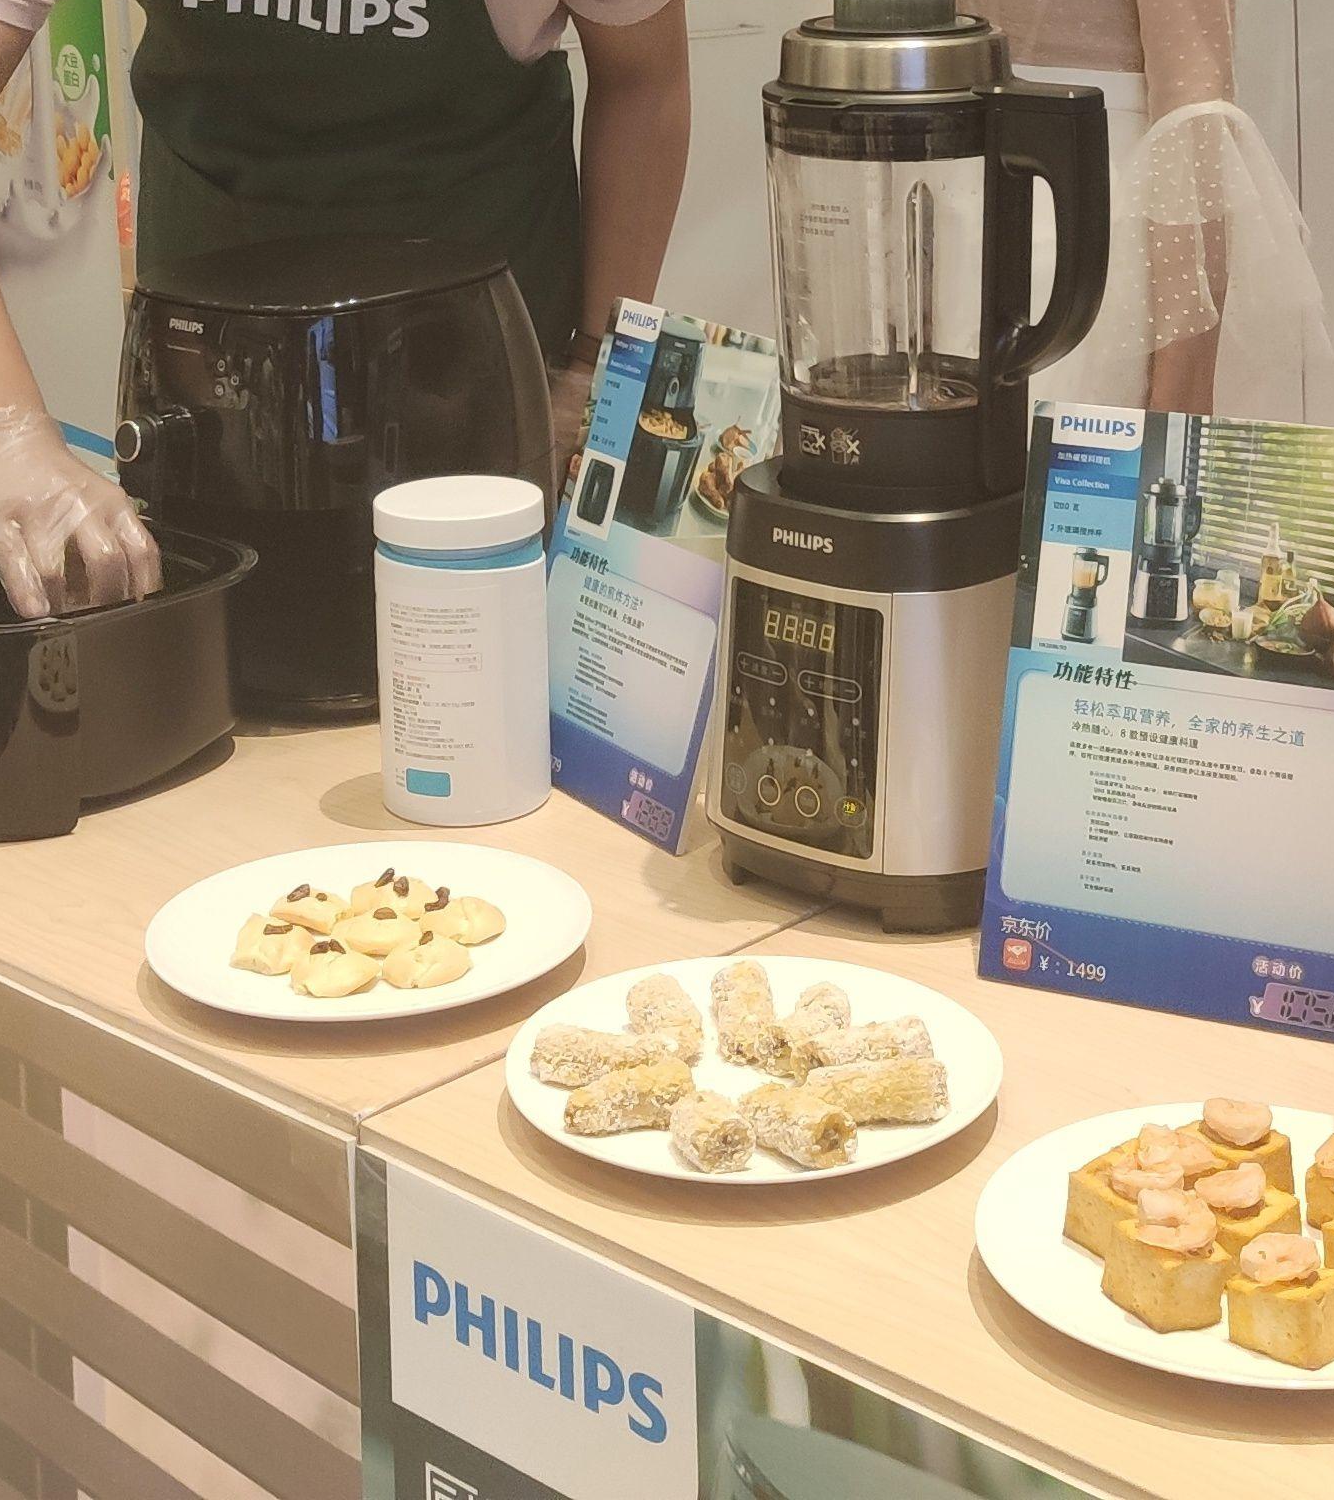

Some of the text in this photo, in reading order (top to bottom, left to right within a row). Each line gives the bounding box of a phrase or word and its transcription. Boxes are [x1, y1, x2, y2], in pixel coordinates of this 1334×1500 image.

[168, 317, 205, 335] PHILIPS
[621, 309, 659, 331] PHILIPS
[1060, 415, 1137, 438] PHILIPS
[1072, 477, 1111, 490] Collection
[771, 526, 834, 554] PHILIPS
[569, 546, 609, 576] 功能特性
[1052, 660, 1136, 691] 功能特性
[1000, 914, 1053, 942] 京东价
[1253, 957, 1304, 981] 活动价
[412, 1259, 668, 1444] PHILIPS
